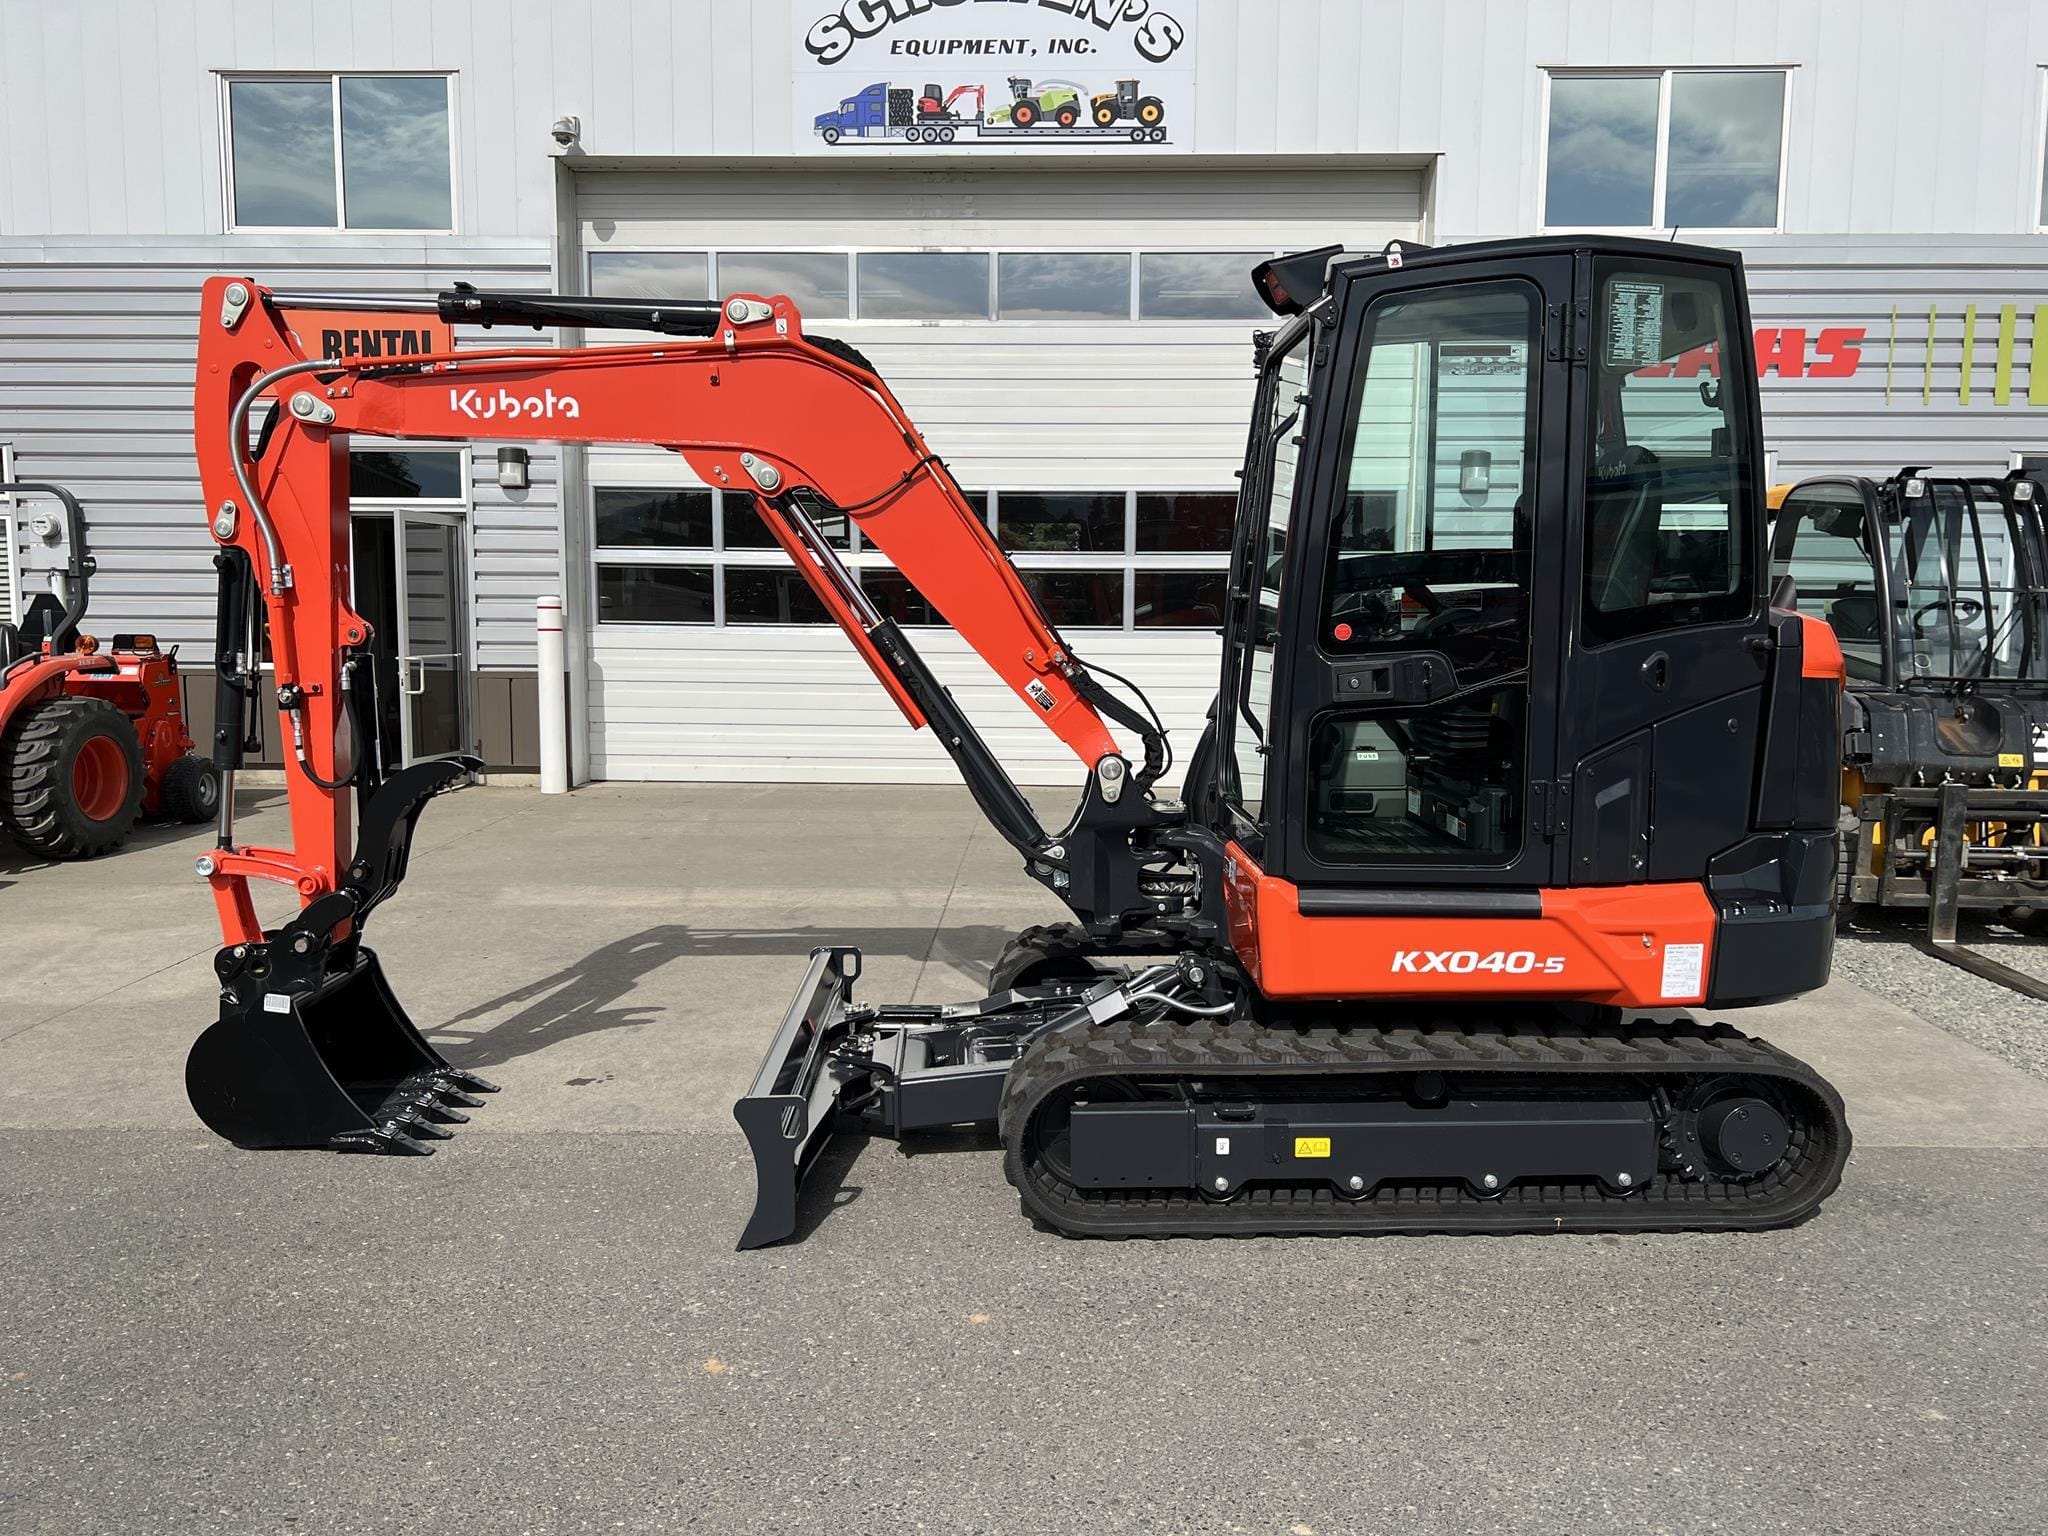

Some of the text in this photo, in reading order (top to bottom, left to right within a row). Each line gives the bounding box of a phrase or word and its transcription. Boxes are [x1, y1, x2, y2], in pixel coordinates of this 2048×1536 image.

[890, 38, 1098, 57] EQUIPMENT, INC.
[450, 388, 580, 419] Kubota
[1391, 950, 1566, 973] KX040-5
